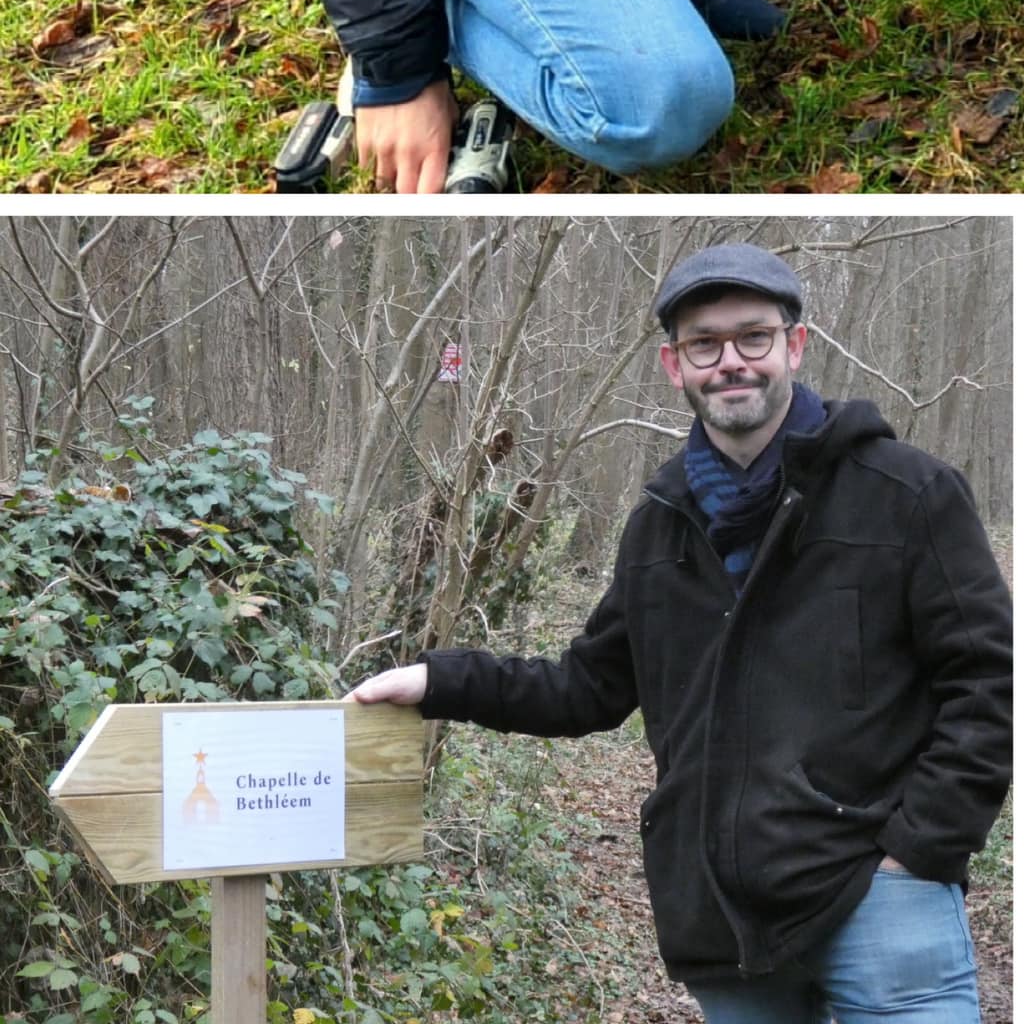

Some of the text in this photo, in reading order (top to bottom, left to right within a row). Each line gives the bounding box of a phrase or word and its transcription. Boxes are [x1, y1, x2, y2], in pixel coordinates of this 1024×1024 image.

[236, 770, 331, 791] Chapelle de
[236, 794, 311, 810] Bethléem
